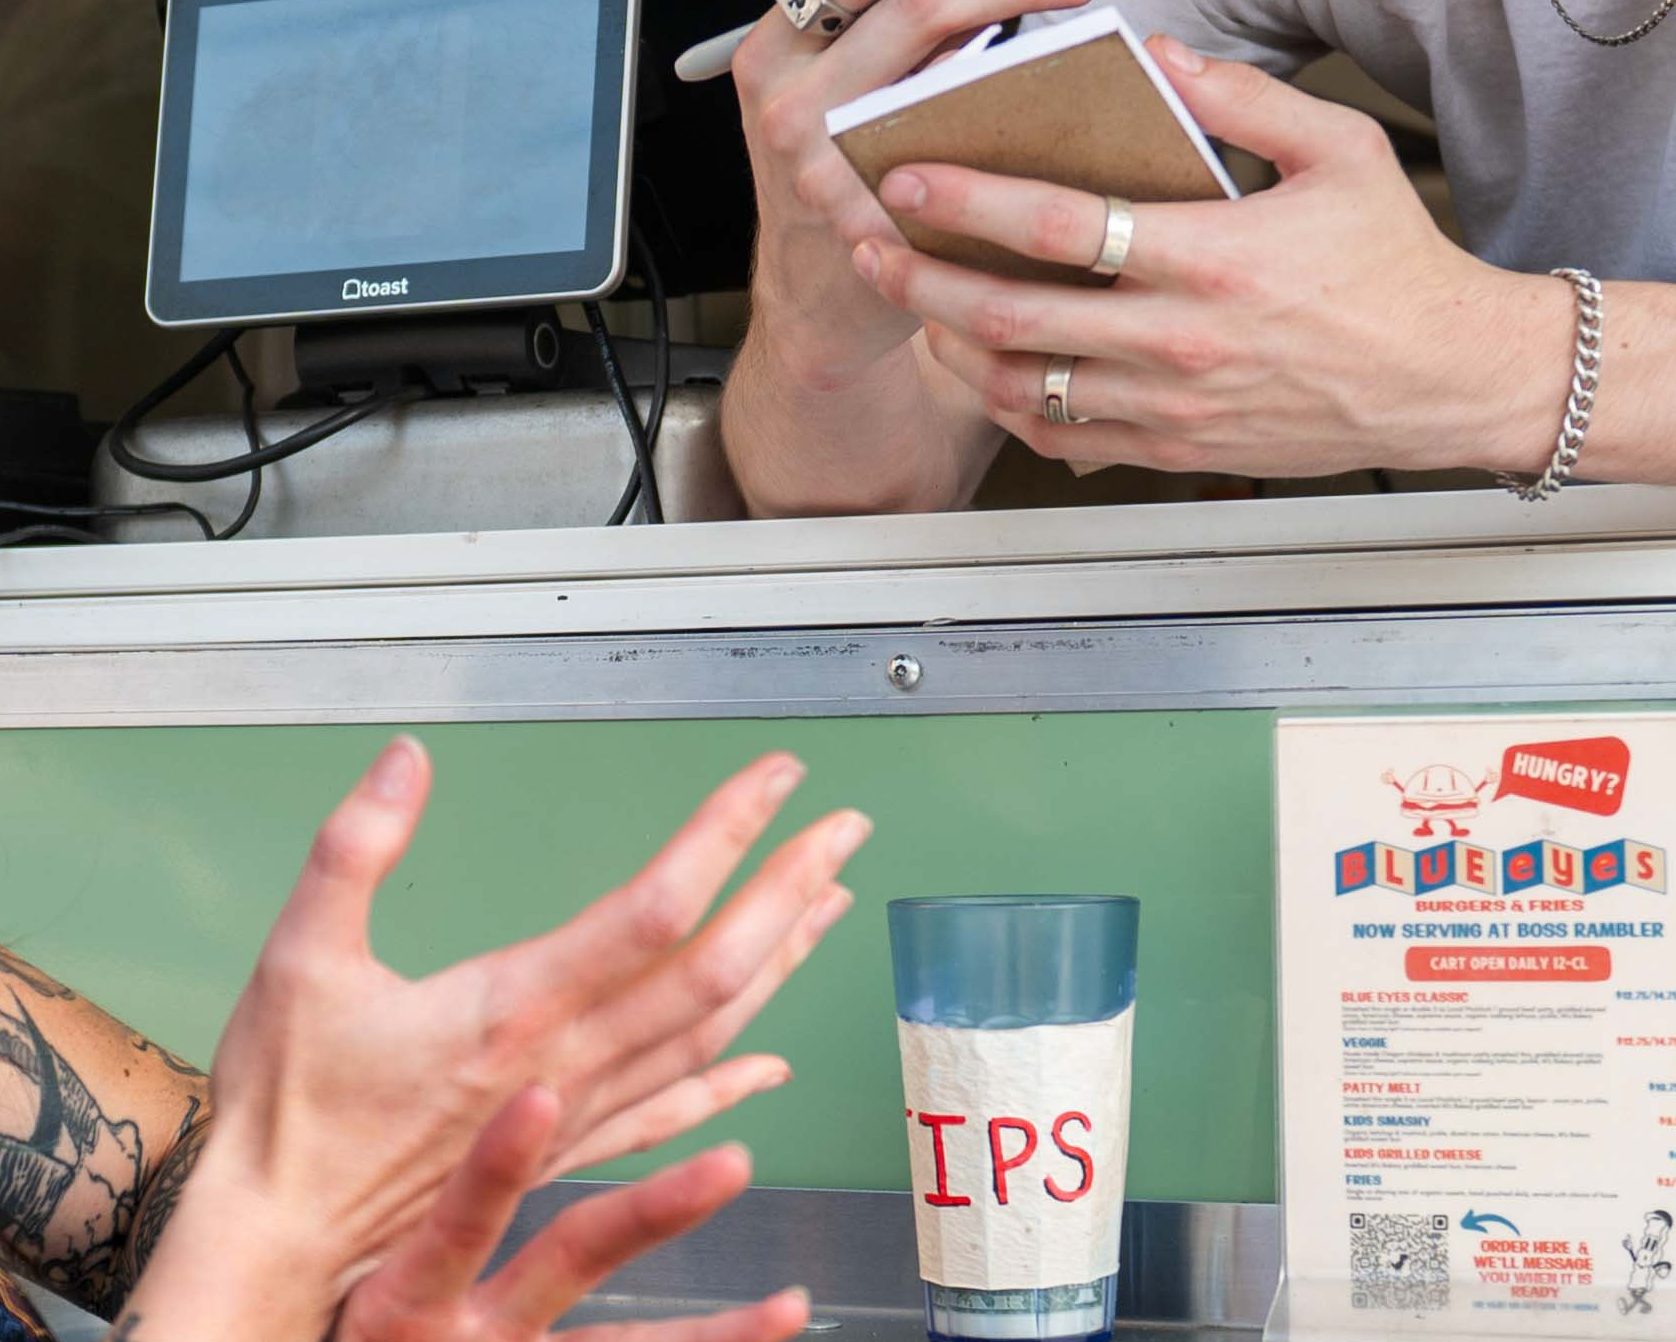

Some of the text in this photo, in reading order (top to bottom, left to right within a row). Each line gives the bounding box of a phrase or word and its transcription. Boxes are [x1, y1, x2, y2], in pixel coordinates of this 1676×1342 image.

[361, 277, 409, 297] toast
[1513, 752, 1621, 796] HUNGRY?
[1341, 848, 1486, 887] BLUE
[1415, 899, 1584, 913] BURGERS & FRIES
[1352, 922, 1664, 939] NOW SERVING AT BOSS RAMBLER
[1430, 956, 1465, 971] CART
[1470, 956, 1506, 971] OPEN
[1509, 956, 1547, 971] DAILY
[1341, 992, 1469, 1003] BLUE EYES CLASSIC
[1343, 1038, 1387, 1048] VEGGIE
[1343, 1083, 1421, 1093] PATTY MELT
[1343, 1116, 1373, 1126] KIDS
[906, 1110, 1094, 1207] IPS
[1344, 1149, 1373, 1159] KIDS
[1434, 1149, 1482, 1160] CHEESE
[1345, 1175, 1382, 1186] FRIES
[1481, 1240, 1588, 1255] ORDER HERE &
[1473, 1256, 1593, 1270] WE'LL MESSAGE
[1479, 1271, 1509, 1283] YOU
[1514, 1272, 1556, 1284] WHEN
[1511, 1286, 1559, 1298] READY
